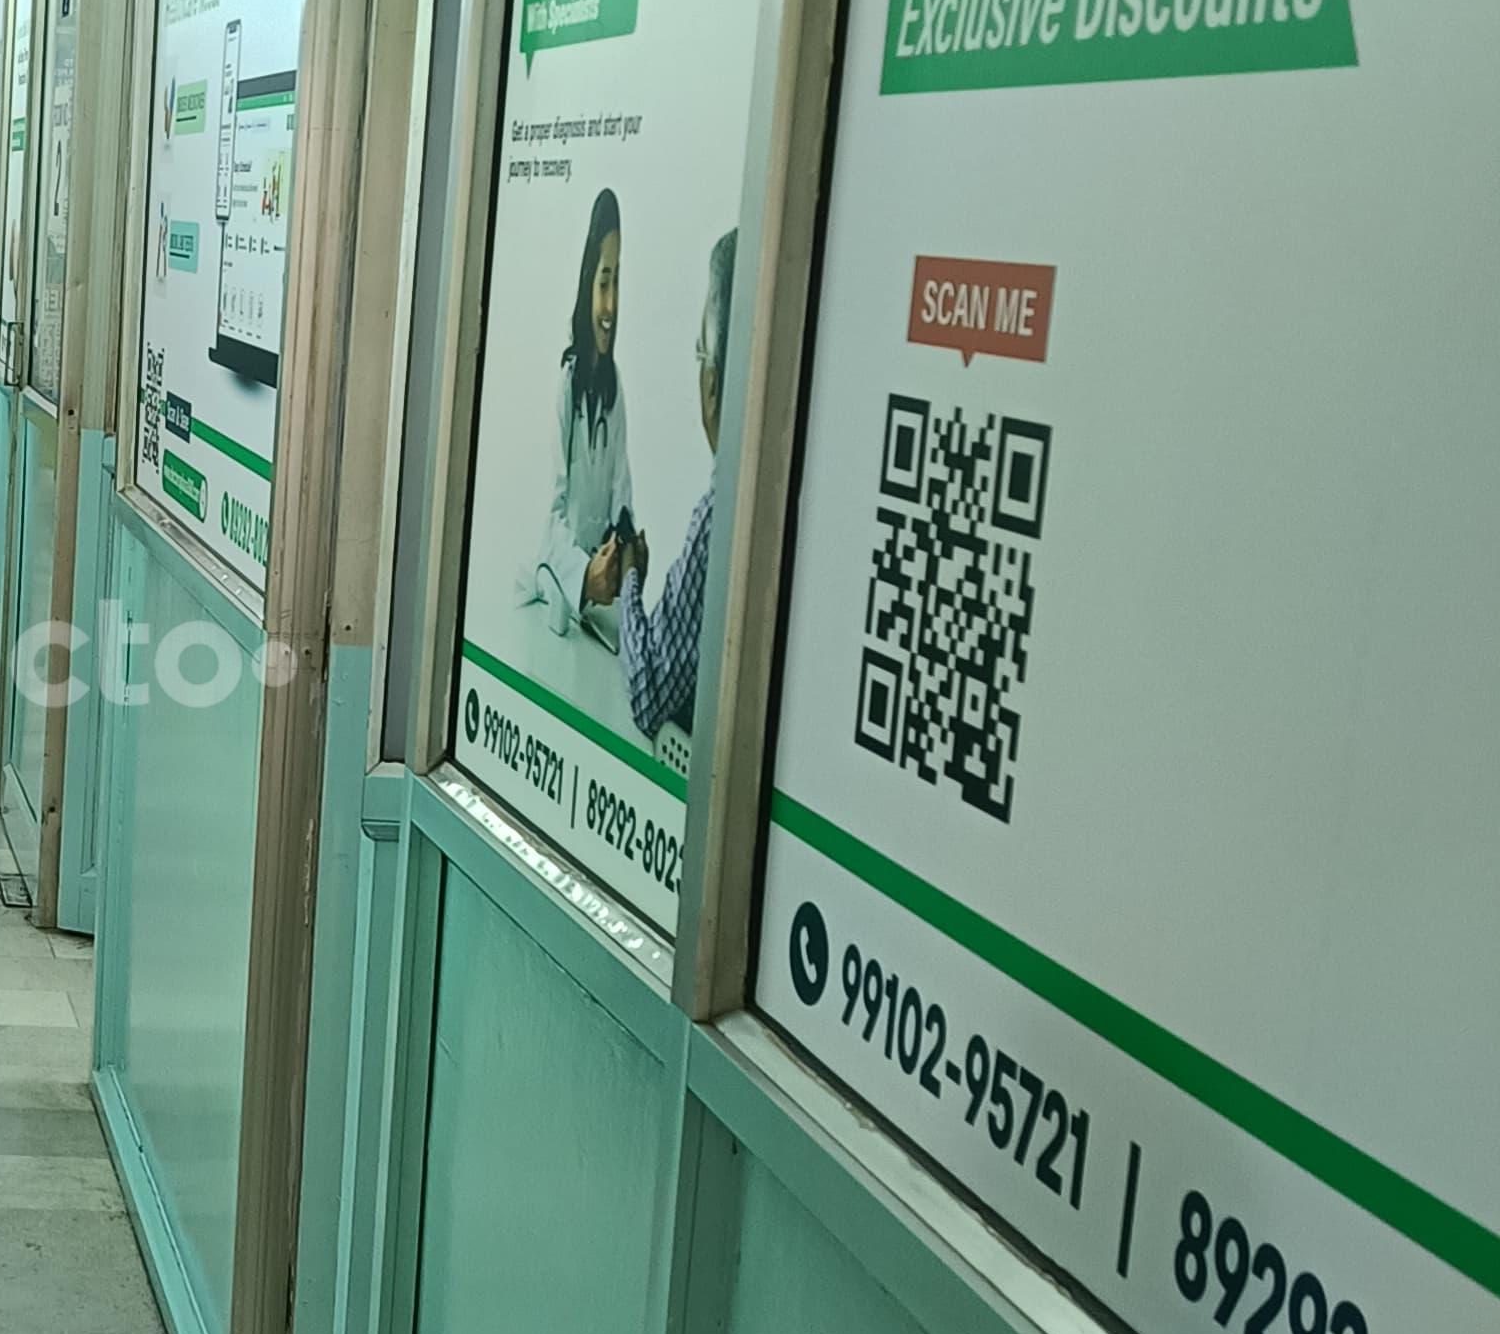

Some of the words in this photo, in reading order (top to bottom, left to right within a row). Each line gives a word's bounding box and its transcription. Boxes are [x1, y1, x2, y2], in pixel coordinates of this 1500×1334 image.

[527, 1, 548, 34] With
[587, 109, 603, 137] and
[921, 279, 990, 330] SCAN
[994, 286, 1038, 337] ME
[483, 704, 565, 805] 99102-95721
[586, 778, 684, 898] 89292-802
[841, 943, 1091, 1212] 99102-95721
